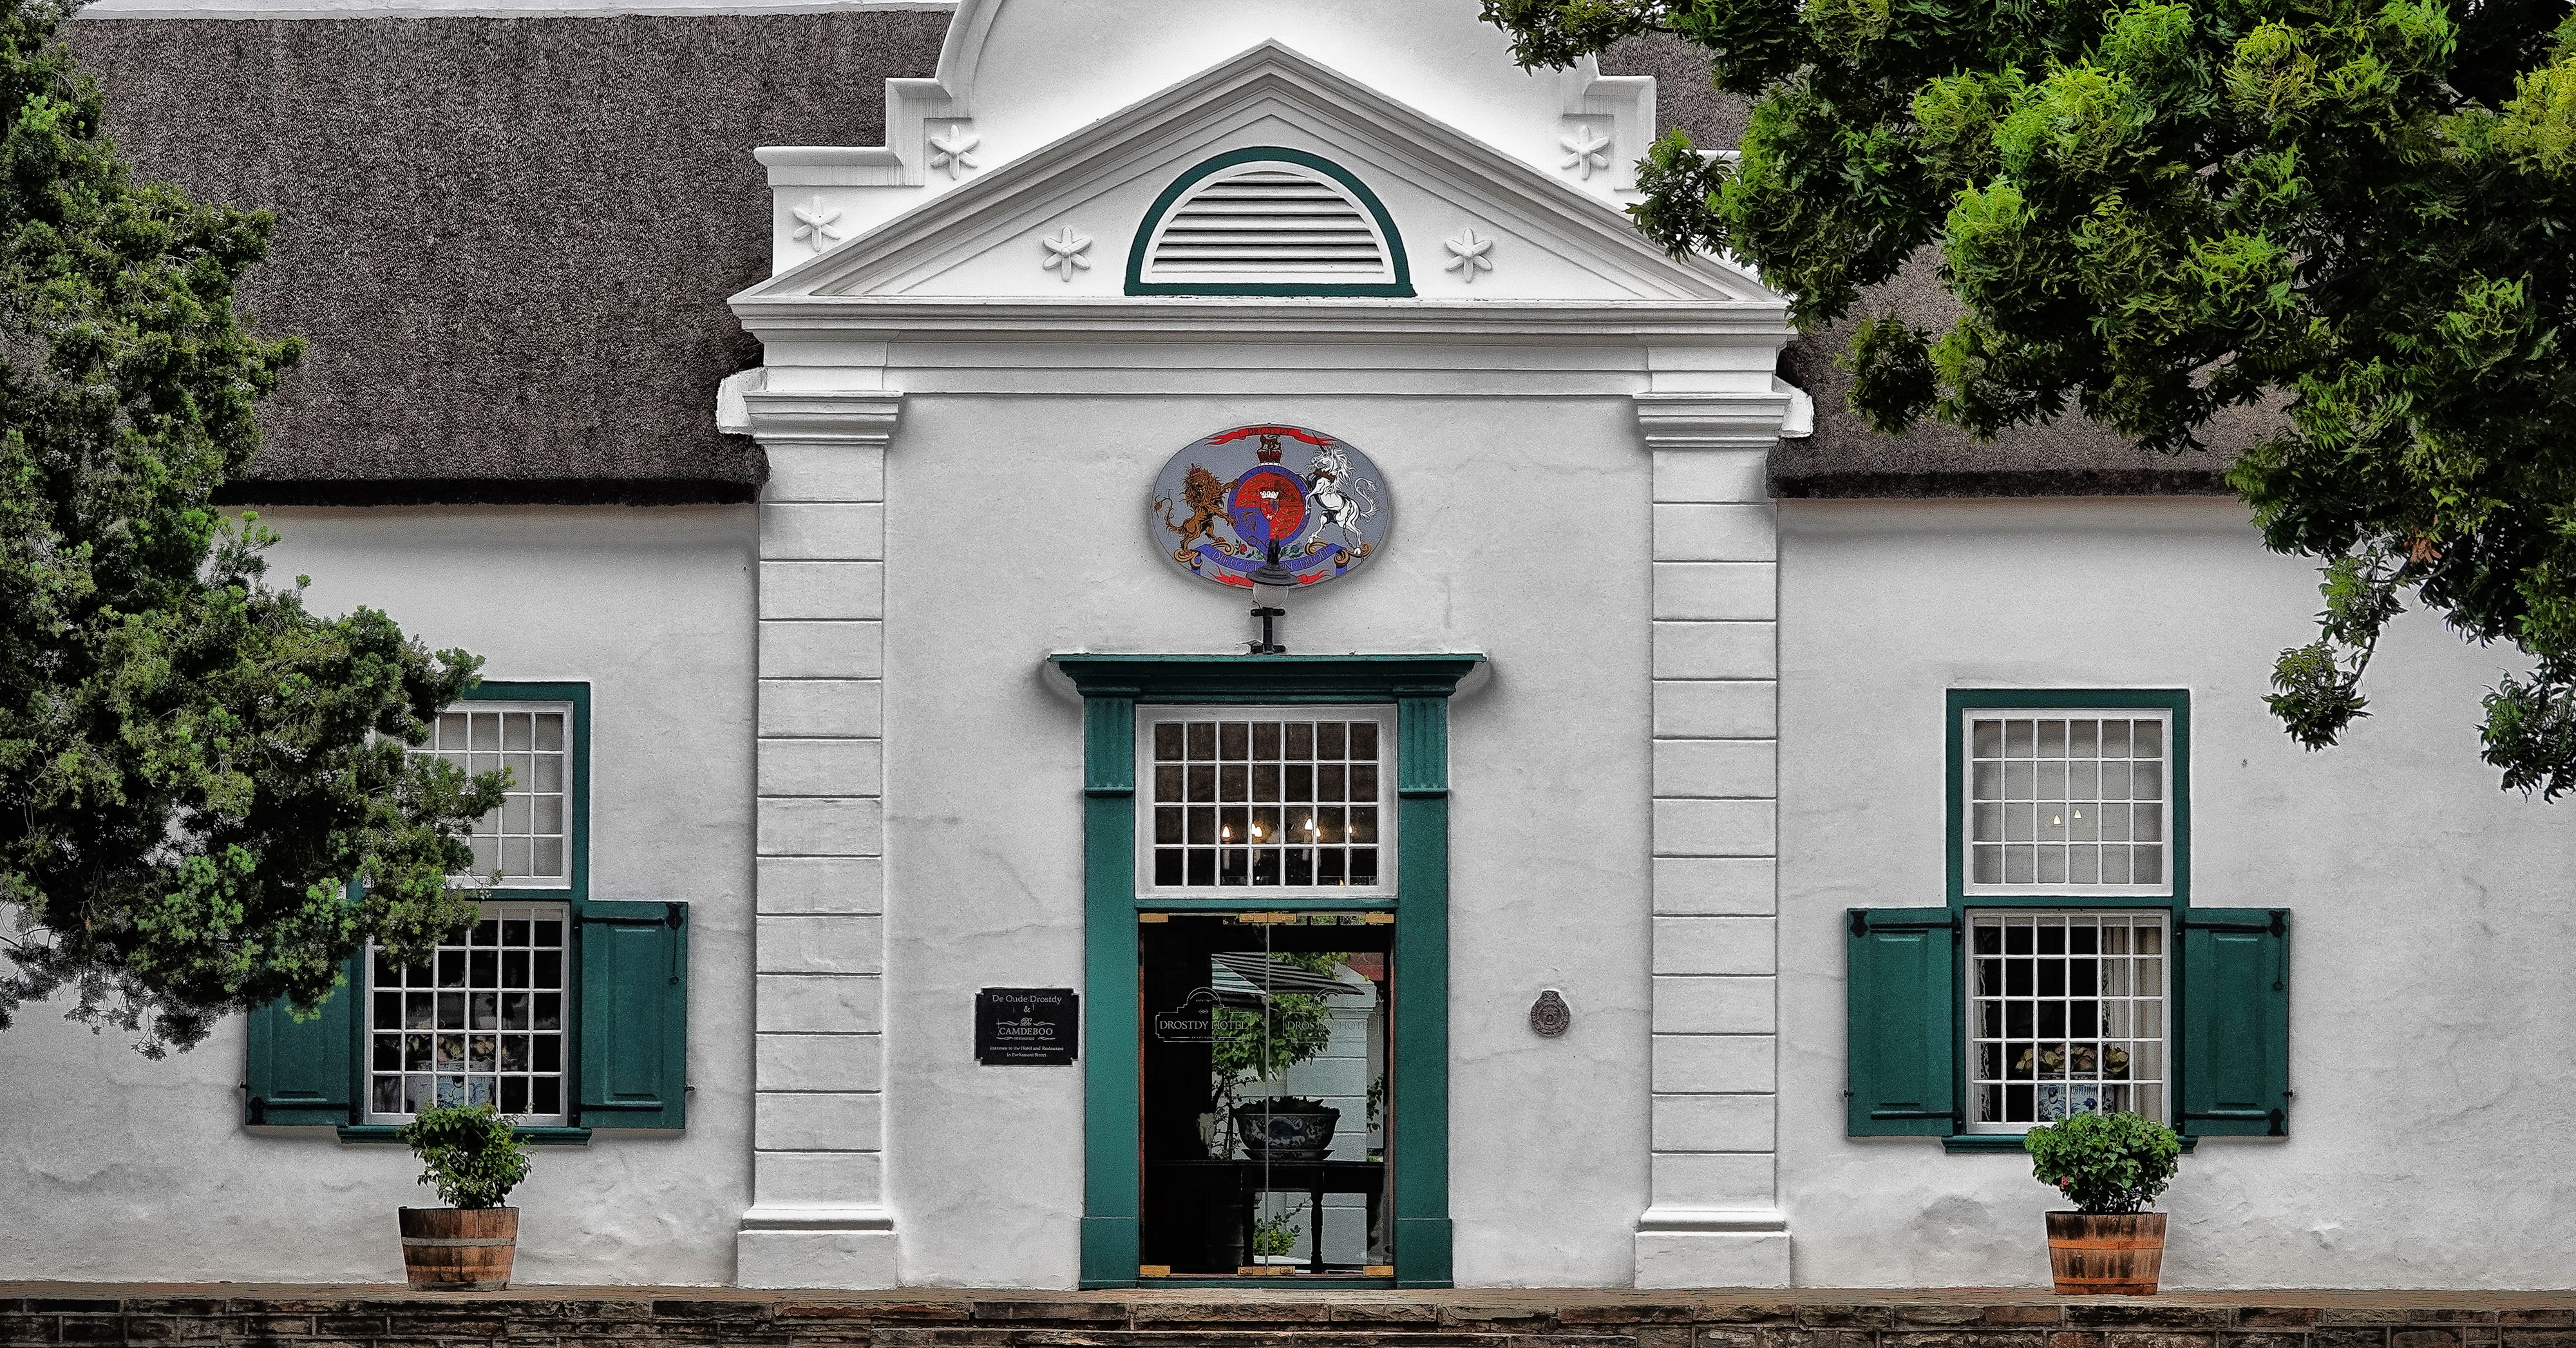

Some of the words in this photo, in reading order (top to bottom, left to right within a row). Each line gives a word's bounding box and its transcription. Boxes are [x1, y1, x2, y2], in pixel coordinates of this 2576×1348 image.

[1211, 551, 1239, 567] DIEU
[1298, 547, 1329, 569] DROIT
[1030, 995, 1062, 1005] Drostdy
[1160, 1020, 1208, 1030] DROSTDY
[1211, 1021, 1248, 1030] HOTEL
[999, 1027, 1053, 1036] CAMDEBOO
